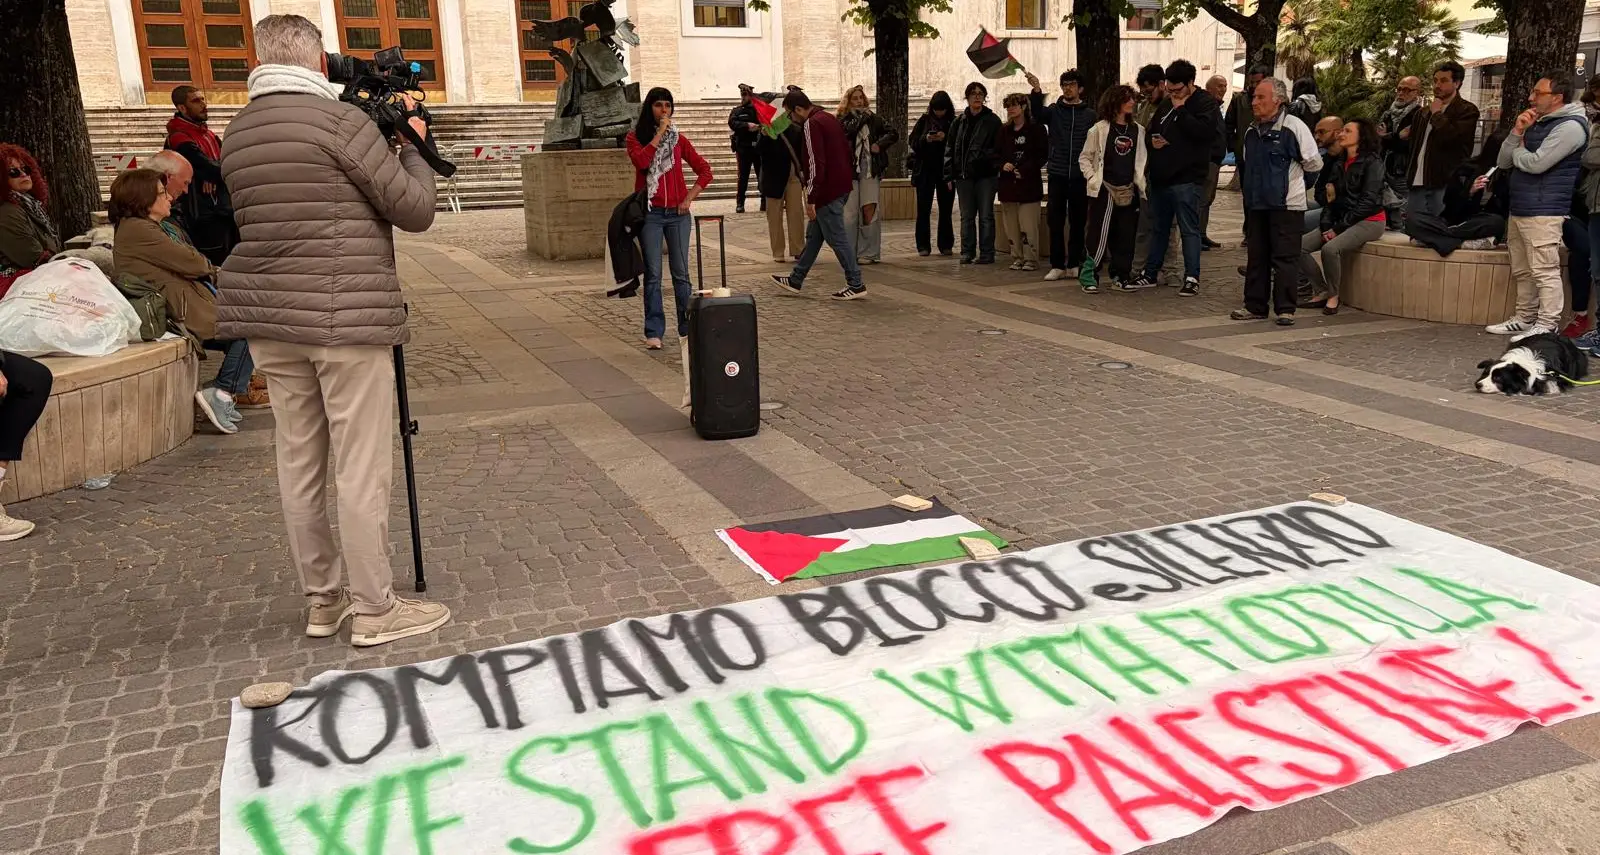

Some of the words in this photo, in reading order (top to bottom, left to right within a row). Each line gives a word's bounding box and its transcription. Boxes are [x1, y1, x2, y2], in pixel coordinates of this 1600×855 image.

[1079, 505, 1395, 592] SILENZIO
[1092, 582, 1147, 601] e
[779, 556, 1087, 656] BLOCCO
[239, 755, 466, 855] WE
[507, 686, 868, 854] STAND
[873, 626, 1191, 732] WITH
[1141, 567, 1538, 671] FLOTILLA
[251, 607, 766, 788] ROMPIAMO
